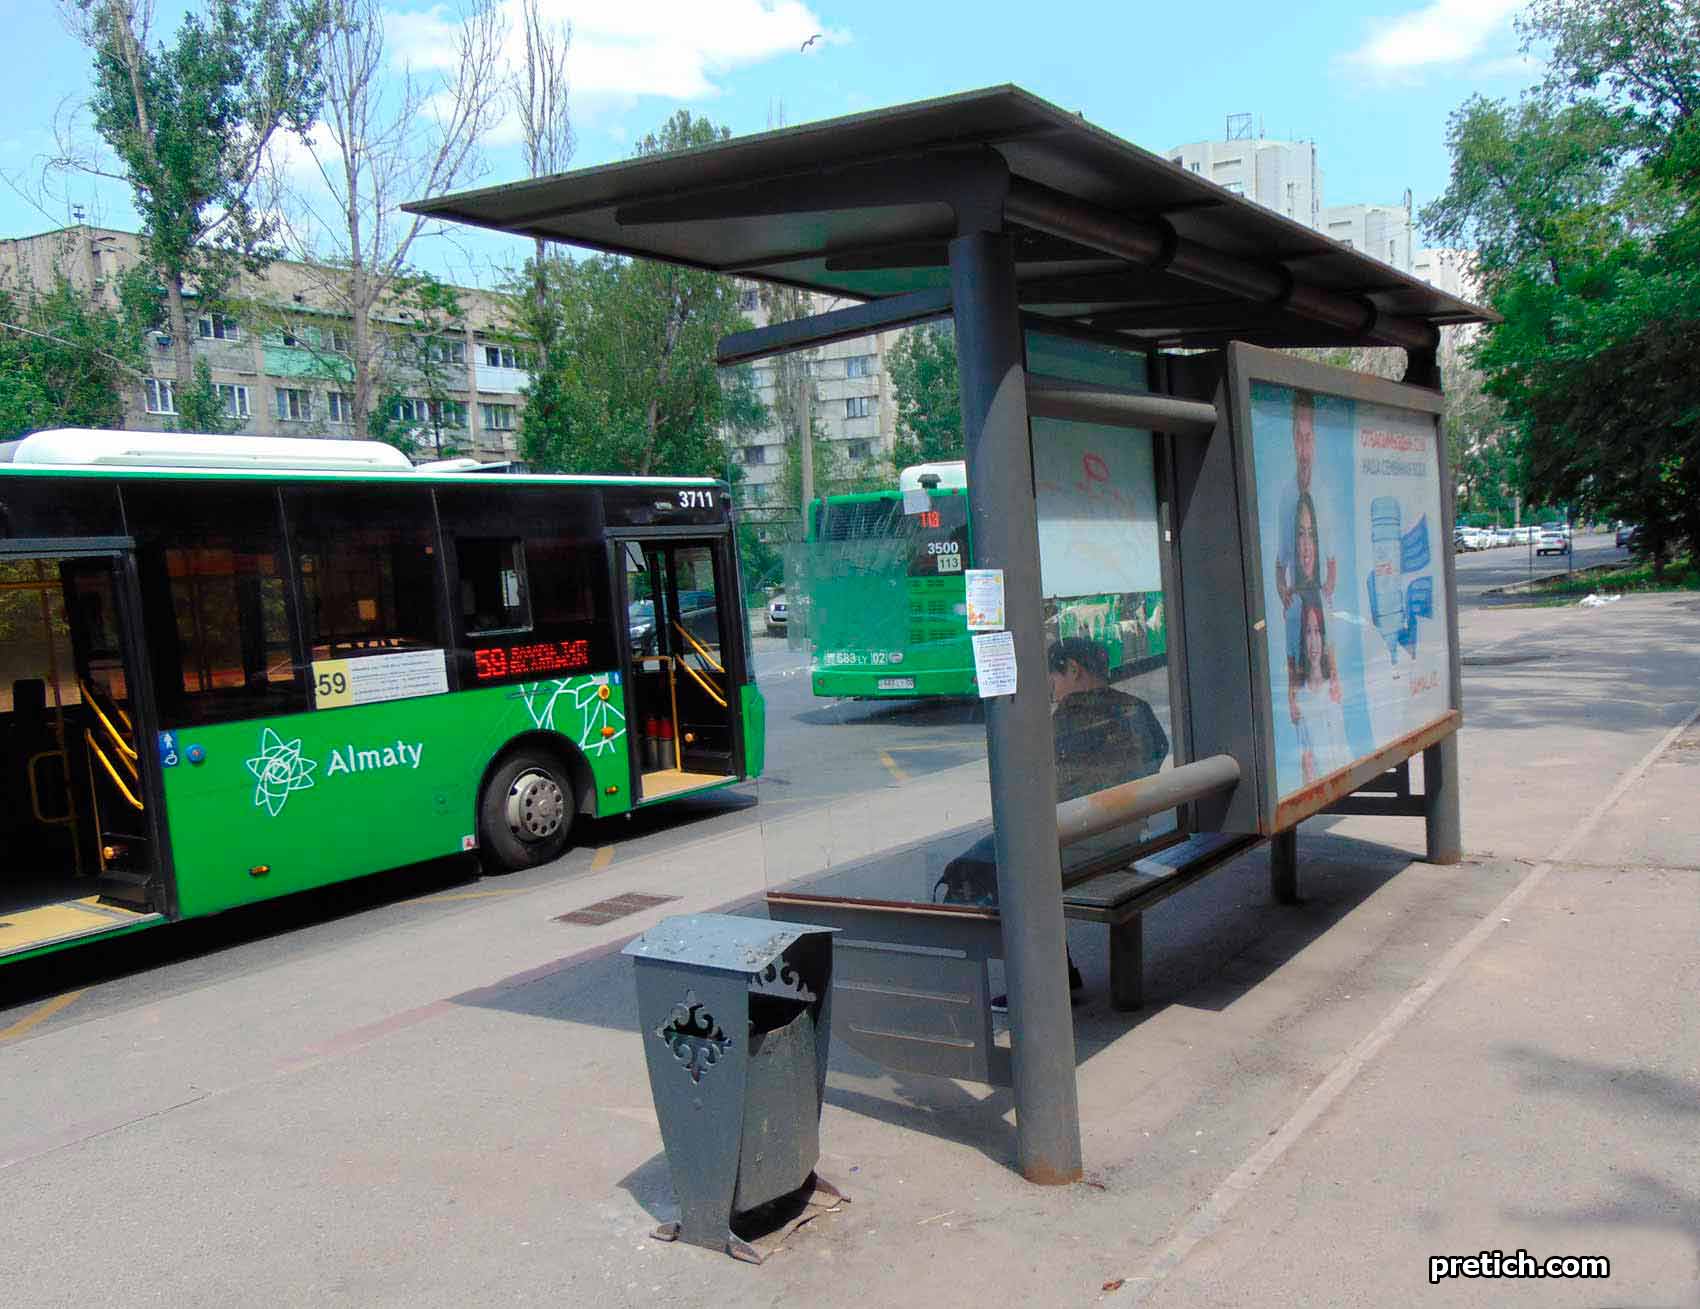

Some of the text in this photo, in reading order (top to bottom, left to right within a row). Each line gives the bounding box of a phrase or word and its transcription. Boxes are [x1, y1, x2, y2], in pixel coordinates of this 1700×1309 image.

[678, 490, 713, 508] 3711
[927, 541, 959, 554] 3500
[940, 557, 959, 569] 113
[475, 647, 508, 678] 59
[317, 671, 347, 696] 59
[327, 739, 424, 777] Almaty
